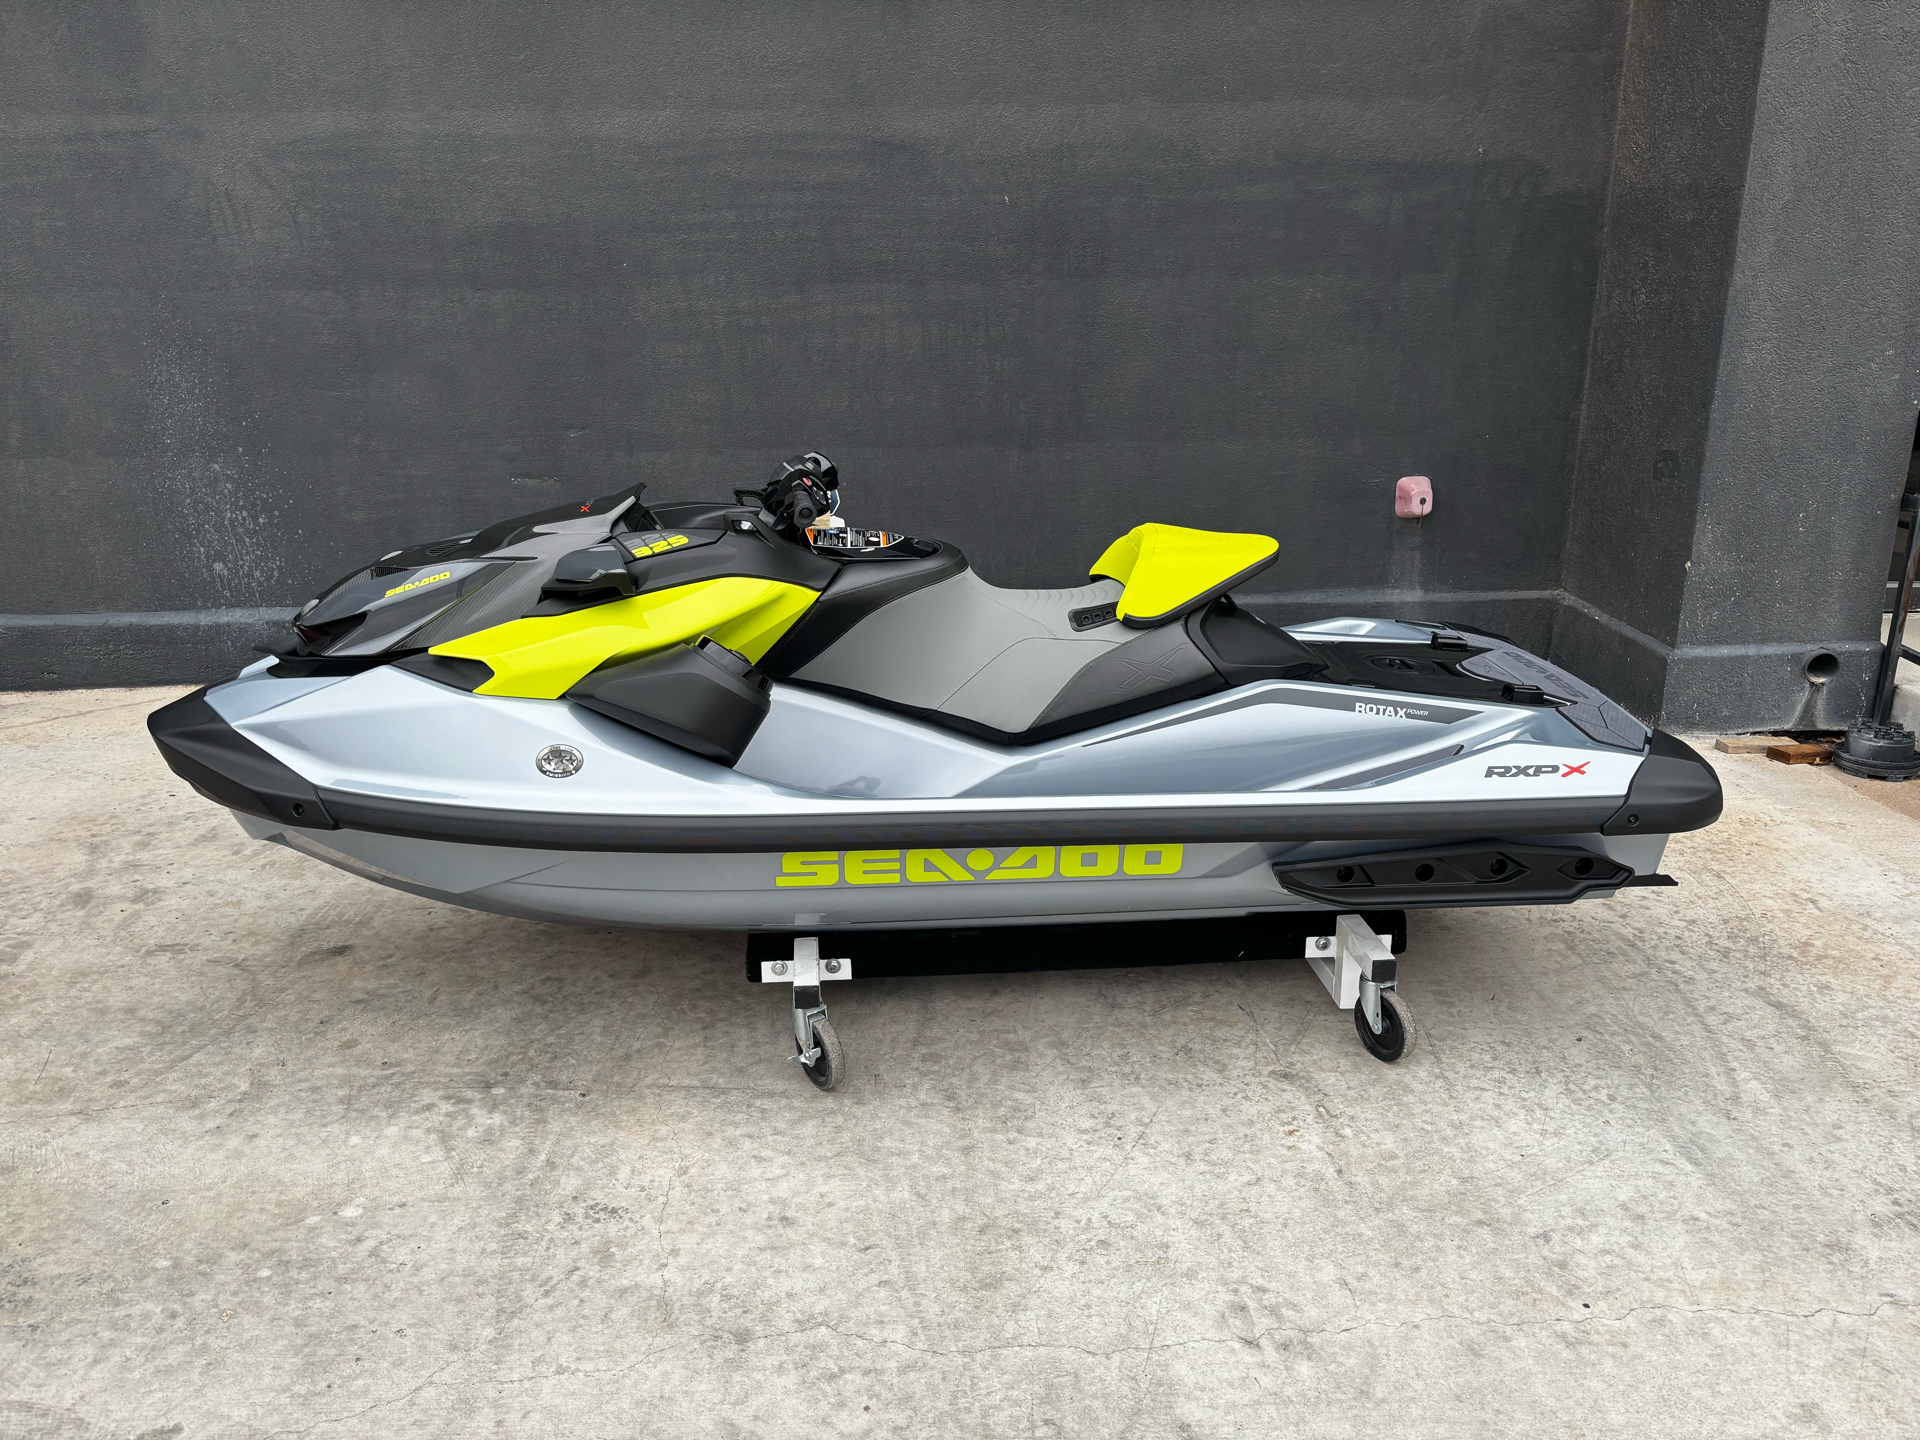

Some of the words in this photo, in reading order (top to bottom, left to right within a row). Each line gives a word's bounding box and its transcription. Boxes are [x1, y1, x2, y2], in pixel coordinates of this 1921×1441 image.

[631, 535, 689, 558] 325
[1355, 702, 1407, 719] ROTAX
[1406, 708, 1429, 716] POWER
[1484, 764, 1560, 778] RXP
[1560, 760, 1591, 778] X
